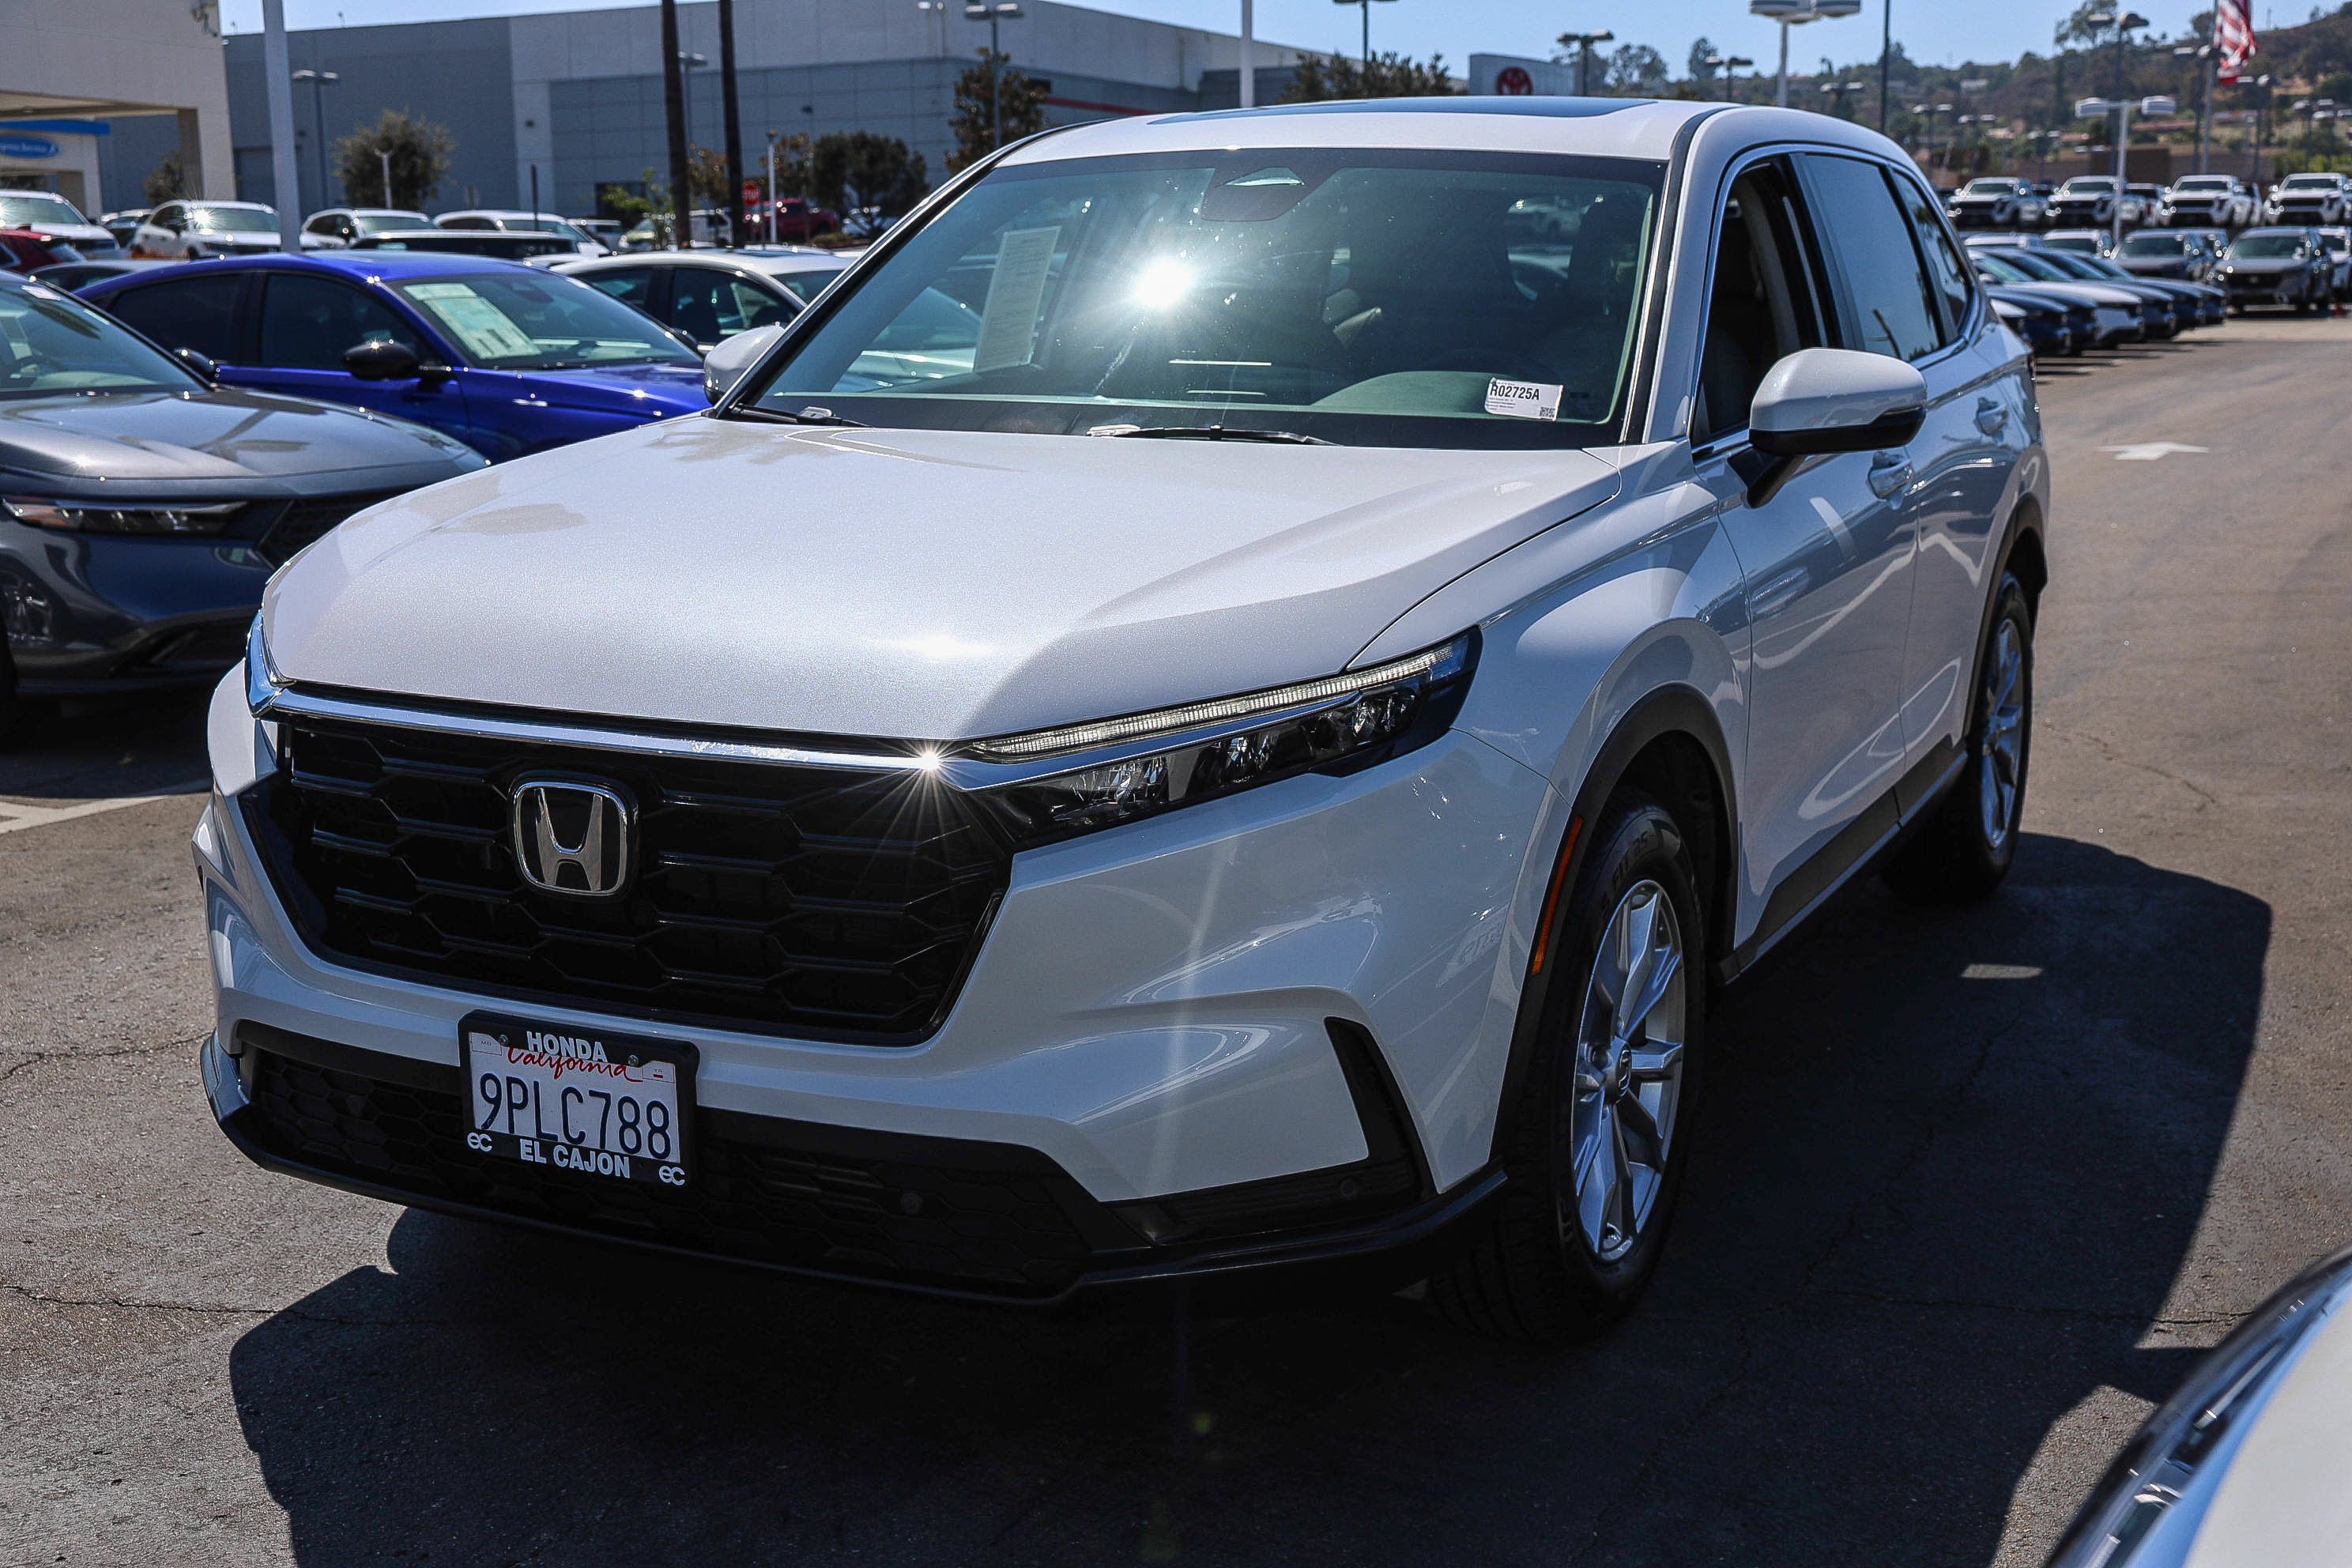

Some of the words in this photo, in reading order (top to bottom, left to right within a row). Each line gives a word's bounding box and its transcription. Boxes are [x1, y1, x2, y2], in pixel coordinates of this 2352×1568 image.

[1489, 384, 1540, 400] R02725A
[526, 1031, 608, 1062] HONDA
[480, 1072, 671, 1159] 9PLC788
[519, 1138, 547, 1164] EL
[553, 1144, 631, 1178] CAJON
